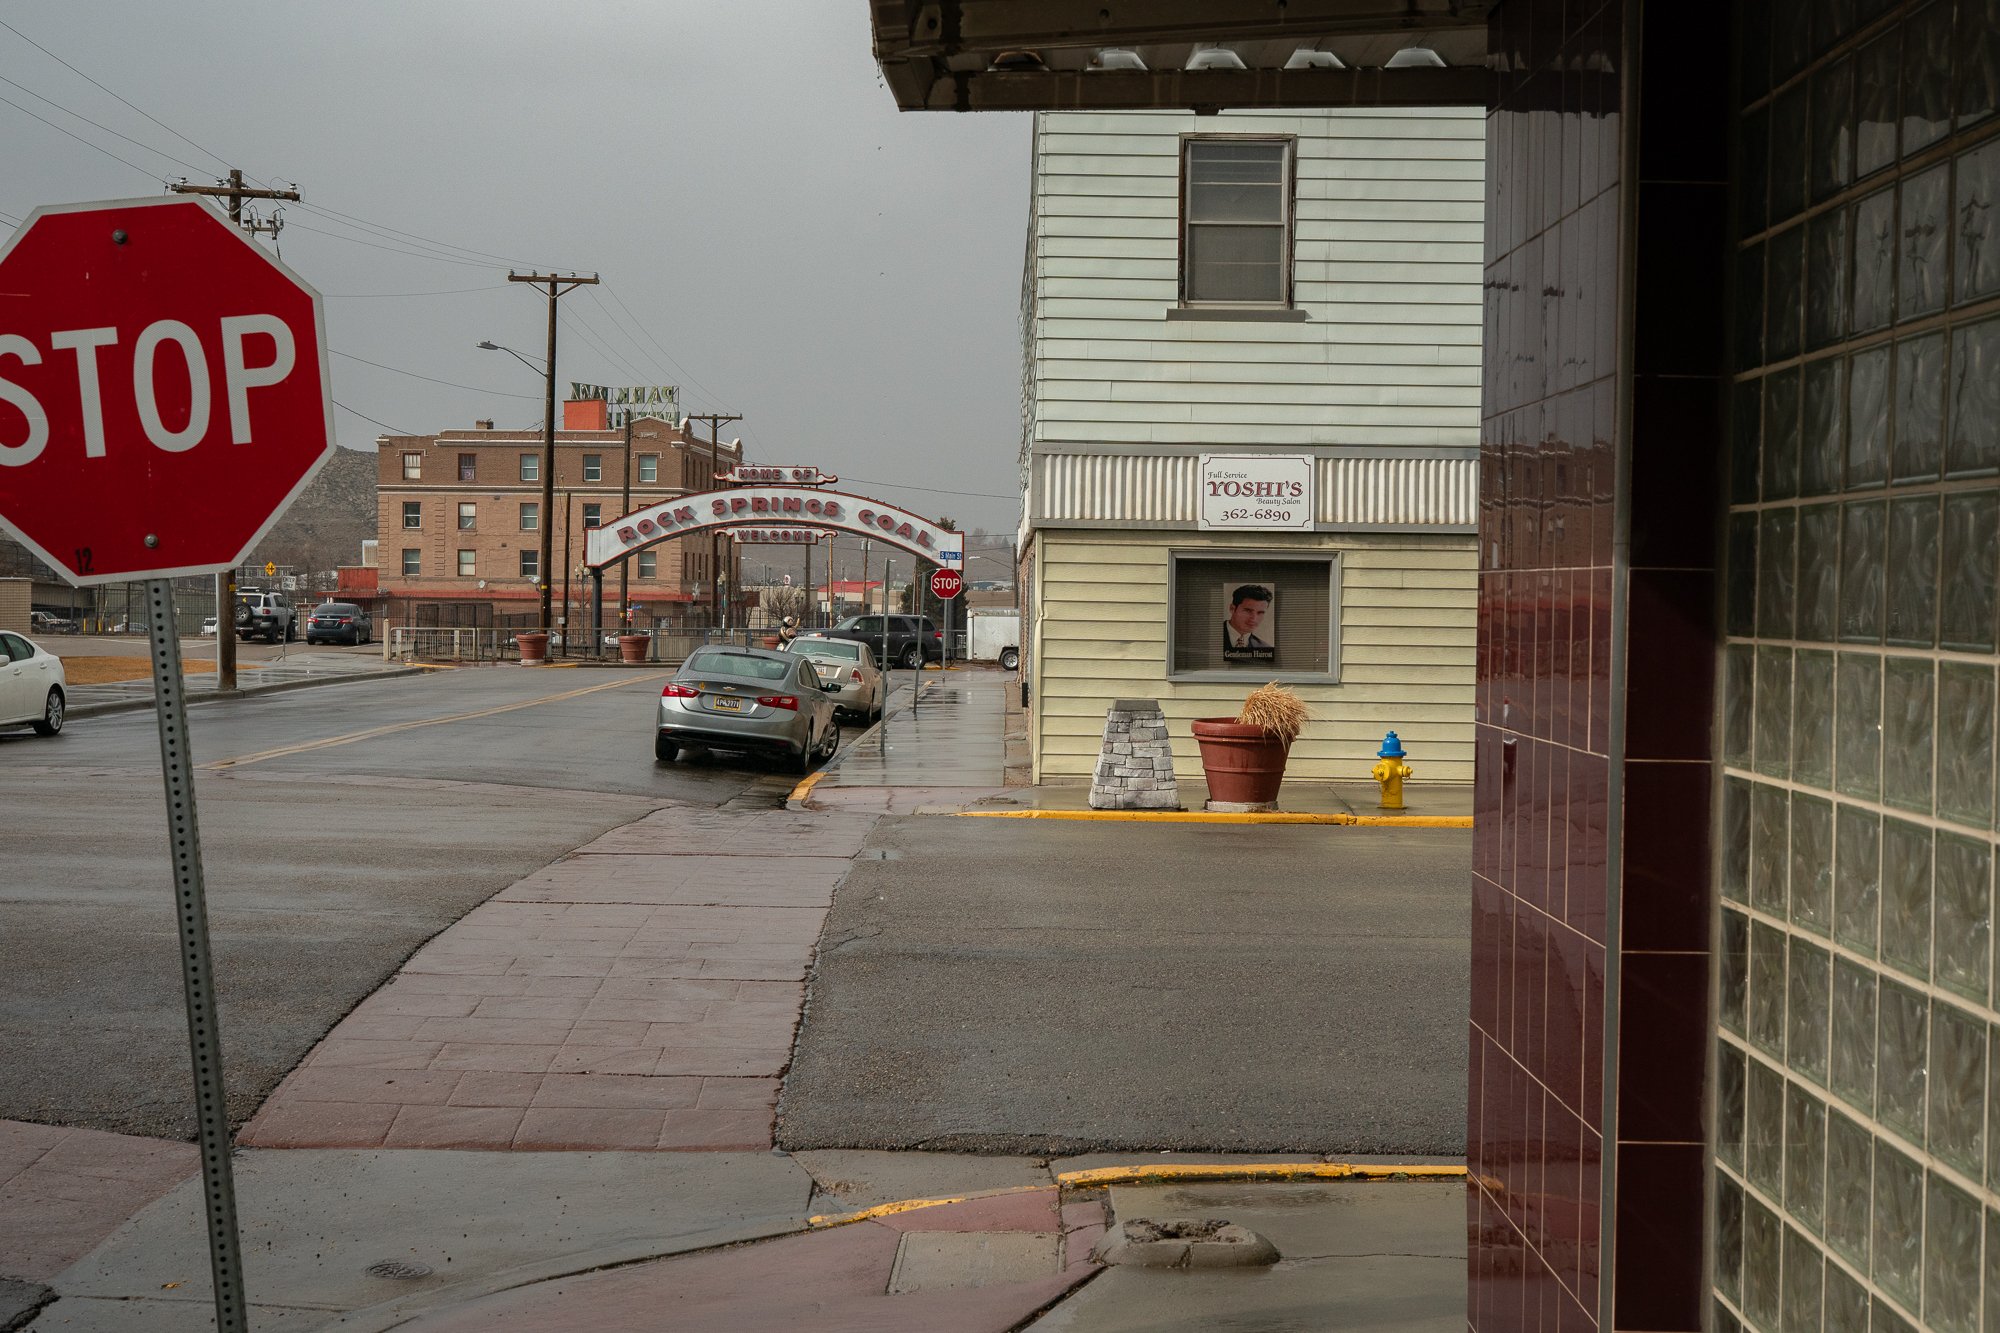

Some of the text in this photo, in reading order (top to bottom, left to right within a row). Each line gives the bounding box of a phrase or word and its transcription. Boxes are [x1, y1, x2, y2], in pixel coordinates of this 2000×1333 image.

[0, 313, 296, 467] STOP
[738, 468, 811, 480] HOME OF
[1207, 471, 1222, 479] Full
[1206, 480, 1304, 497] YOSHI'S
[1255, 498, 1301, 506] Beauty Salon
[1220, 508, 1291, 522] 362-6890
[617, 497, 932, 548] ROCK SPRINGS COAL
[737, 530, 812, 542] WELCOME
[75, 547, 94, 573] 12
[934, 578, 960, 590] STOP
